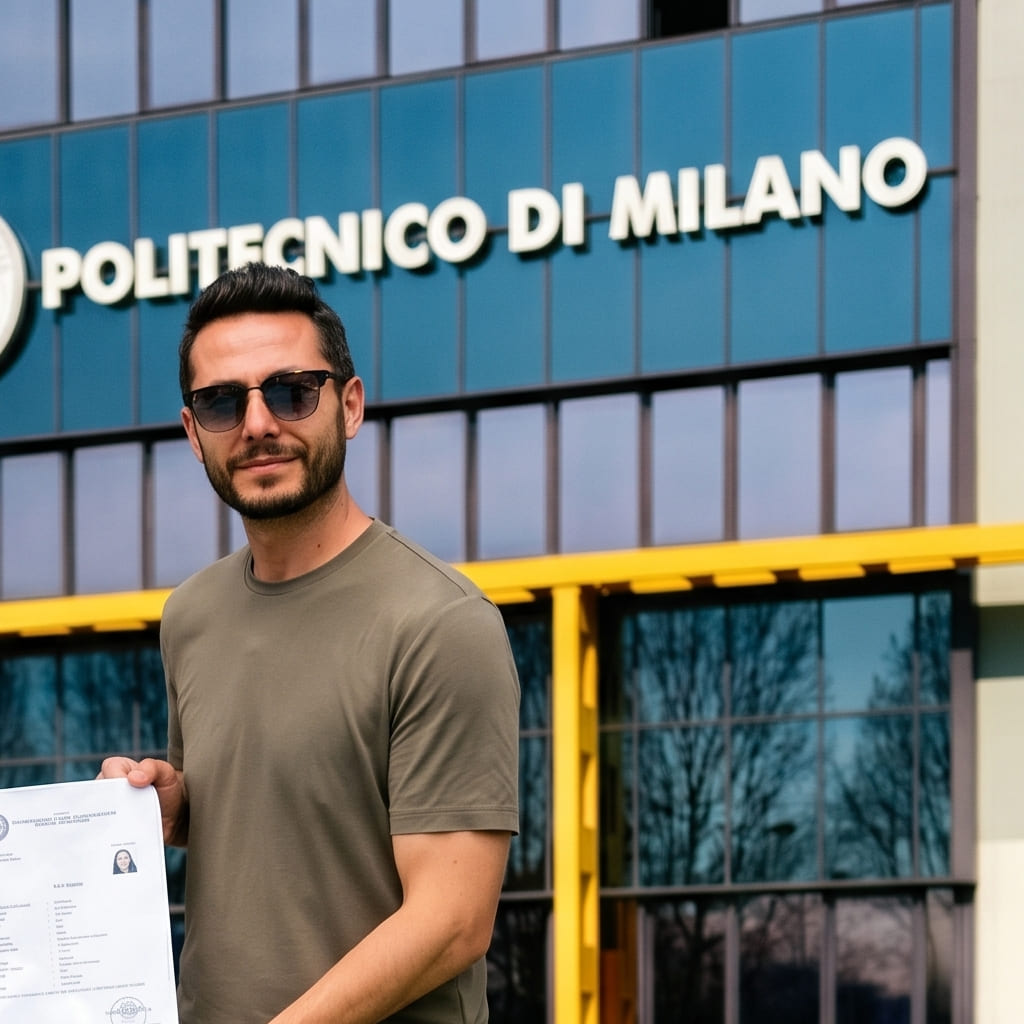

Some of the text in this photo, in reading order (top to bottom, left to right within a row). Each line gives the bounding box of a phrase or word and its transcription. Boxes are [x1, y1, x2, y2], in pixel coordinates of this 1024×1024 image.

[42, 196, 488, 310] POLITECNICO
[508, 182, 585, 254] DI
[609, 136, 928, 242] MILANO
